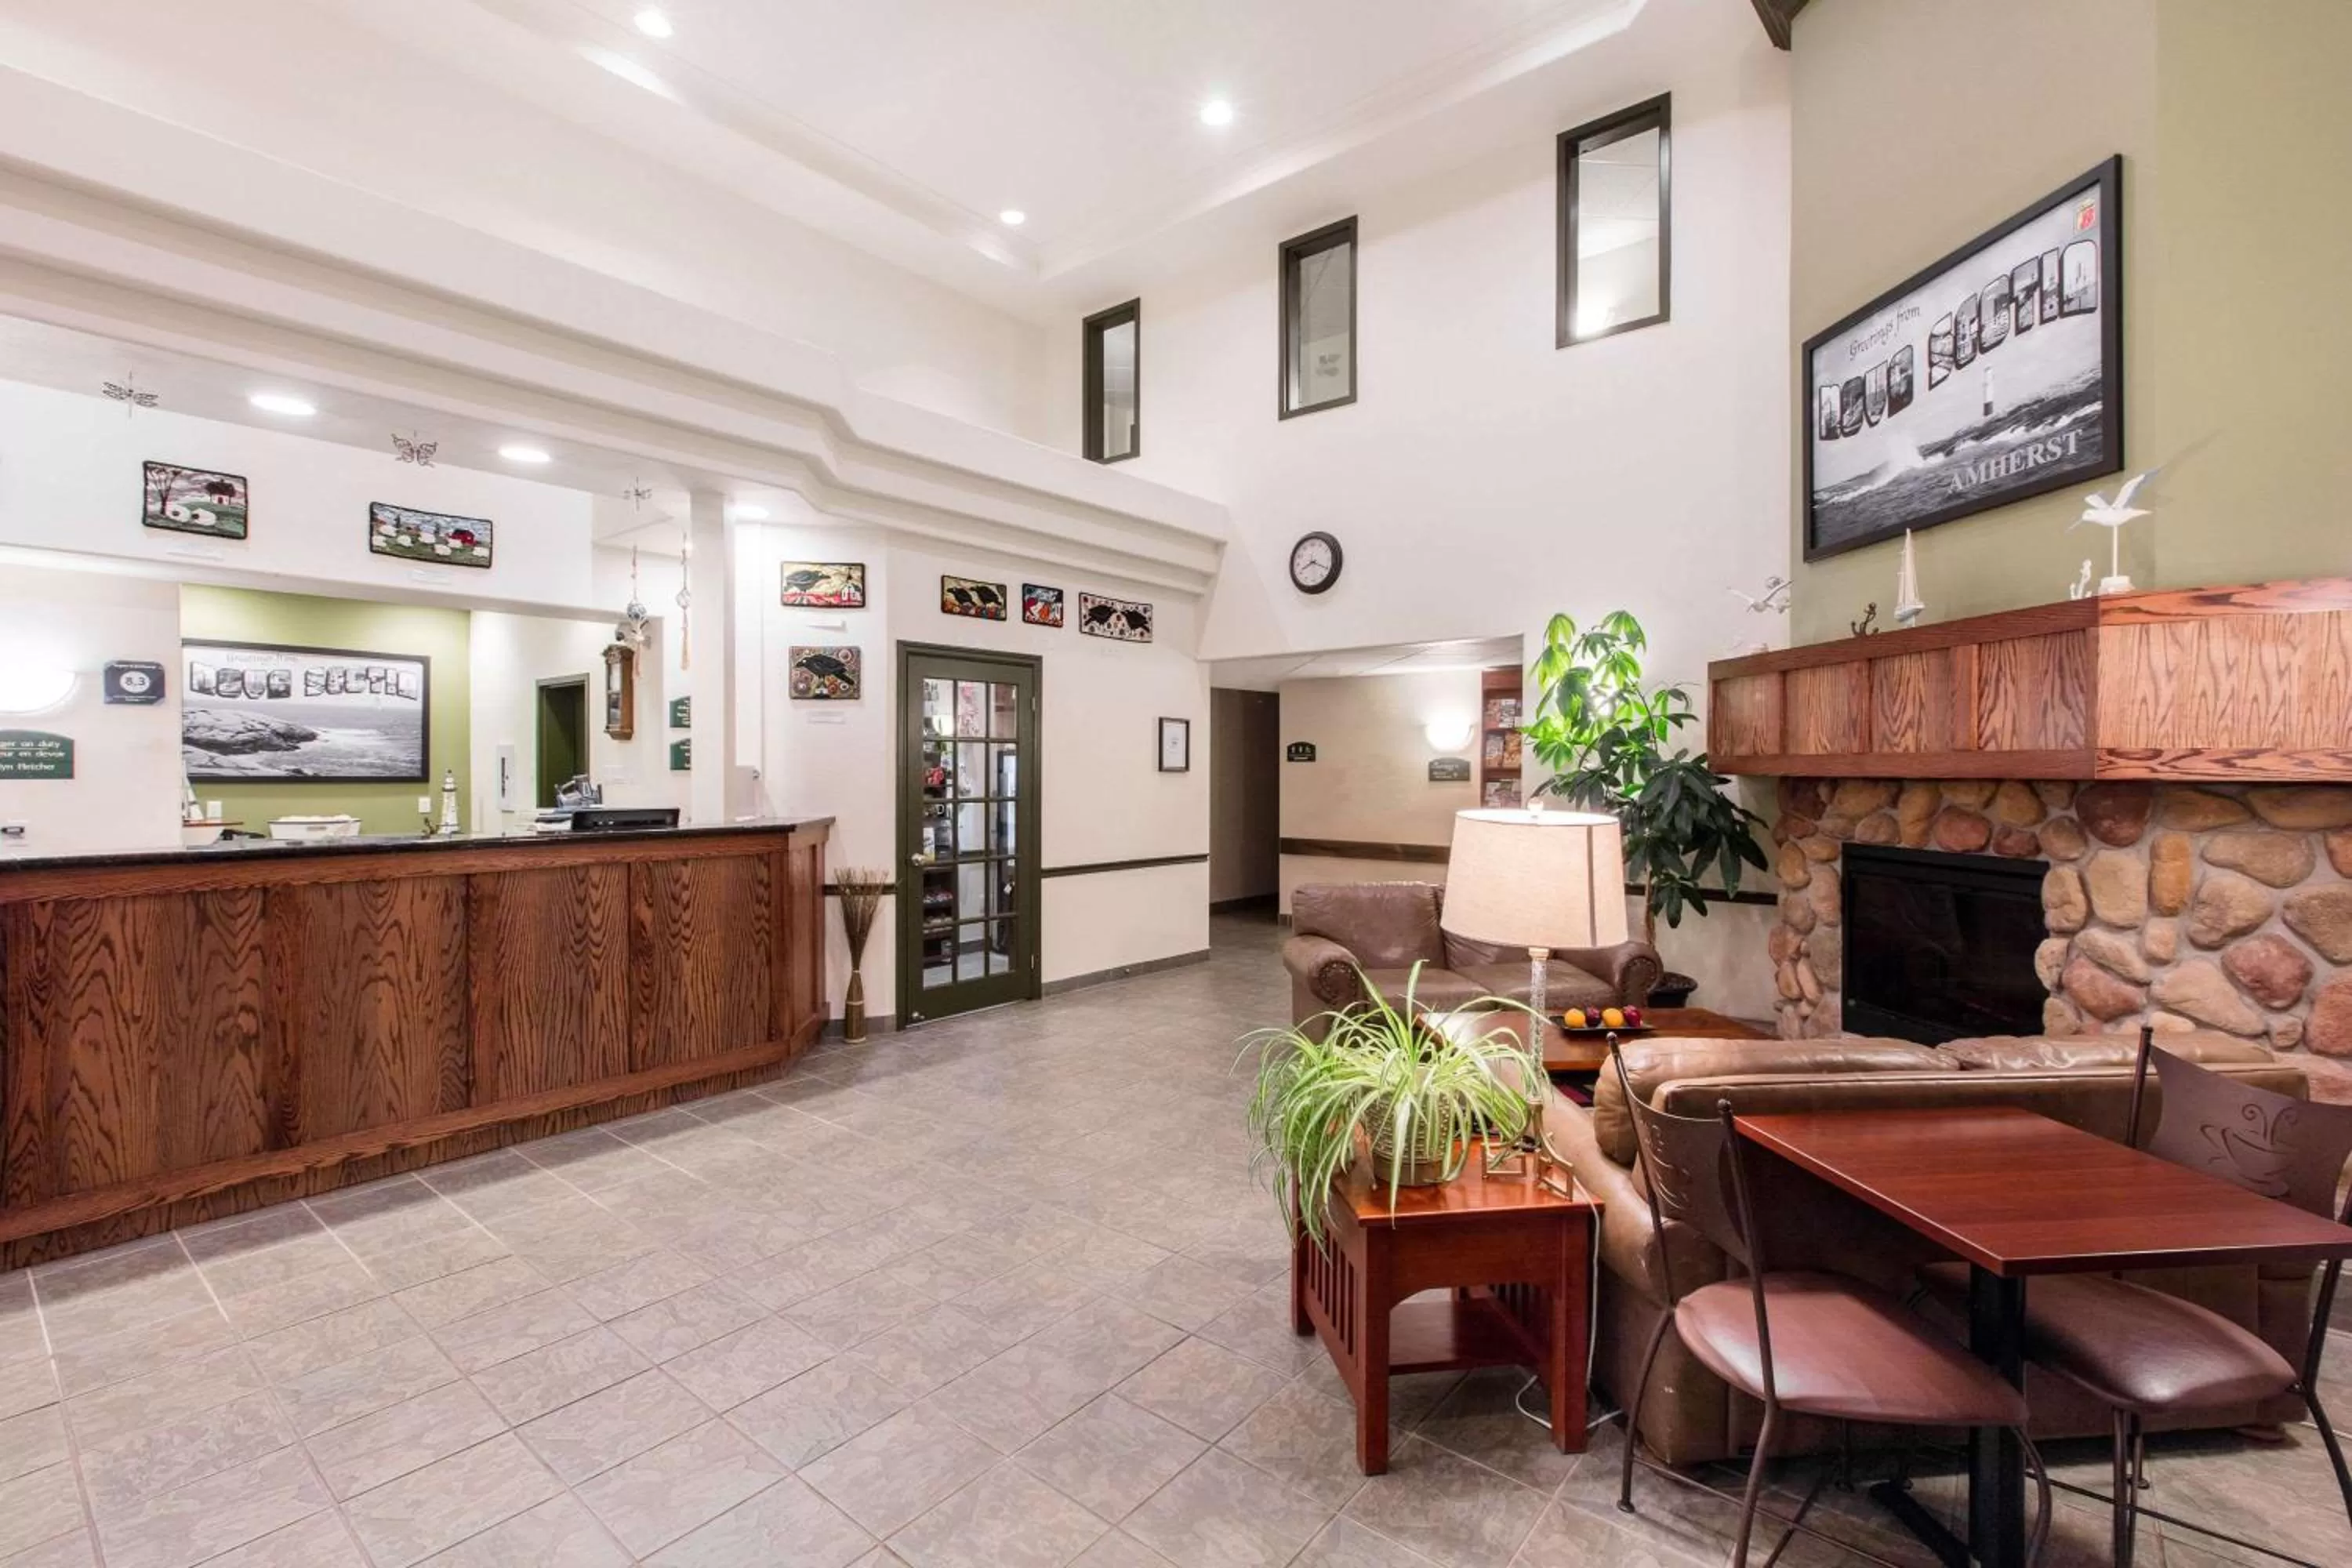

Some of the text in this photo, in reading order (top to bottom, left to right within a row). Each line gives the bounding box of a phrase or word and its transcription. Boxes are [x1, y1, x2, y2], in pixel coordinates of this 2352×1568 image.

[1849, 307, 1920, 361] Greetings from
[1947, 429, 2082, 494] AMHERST
